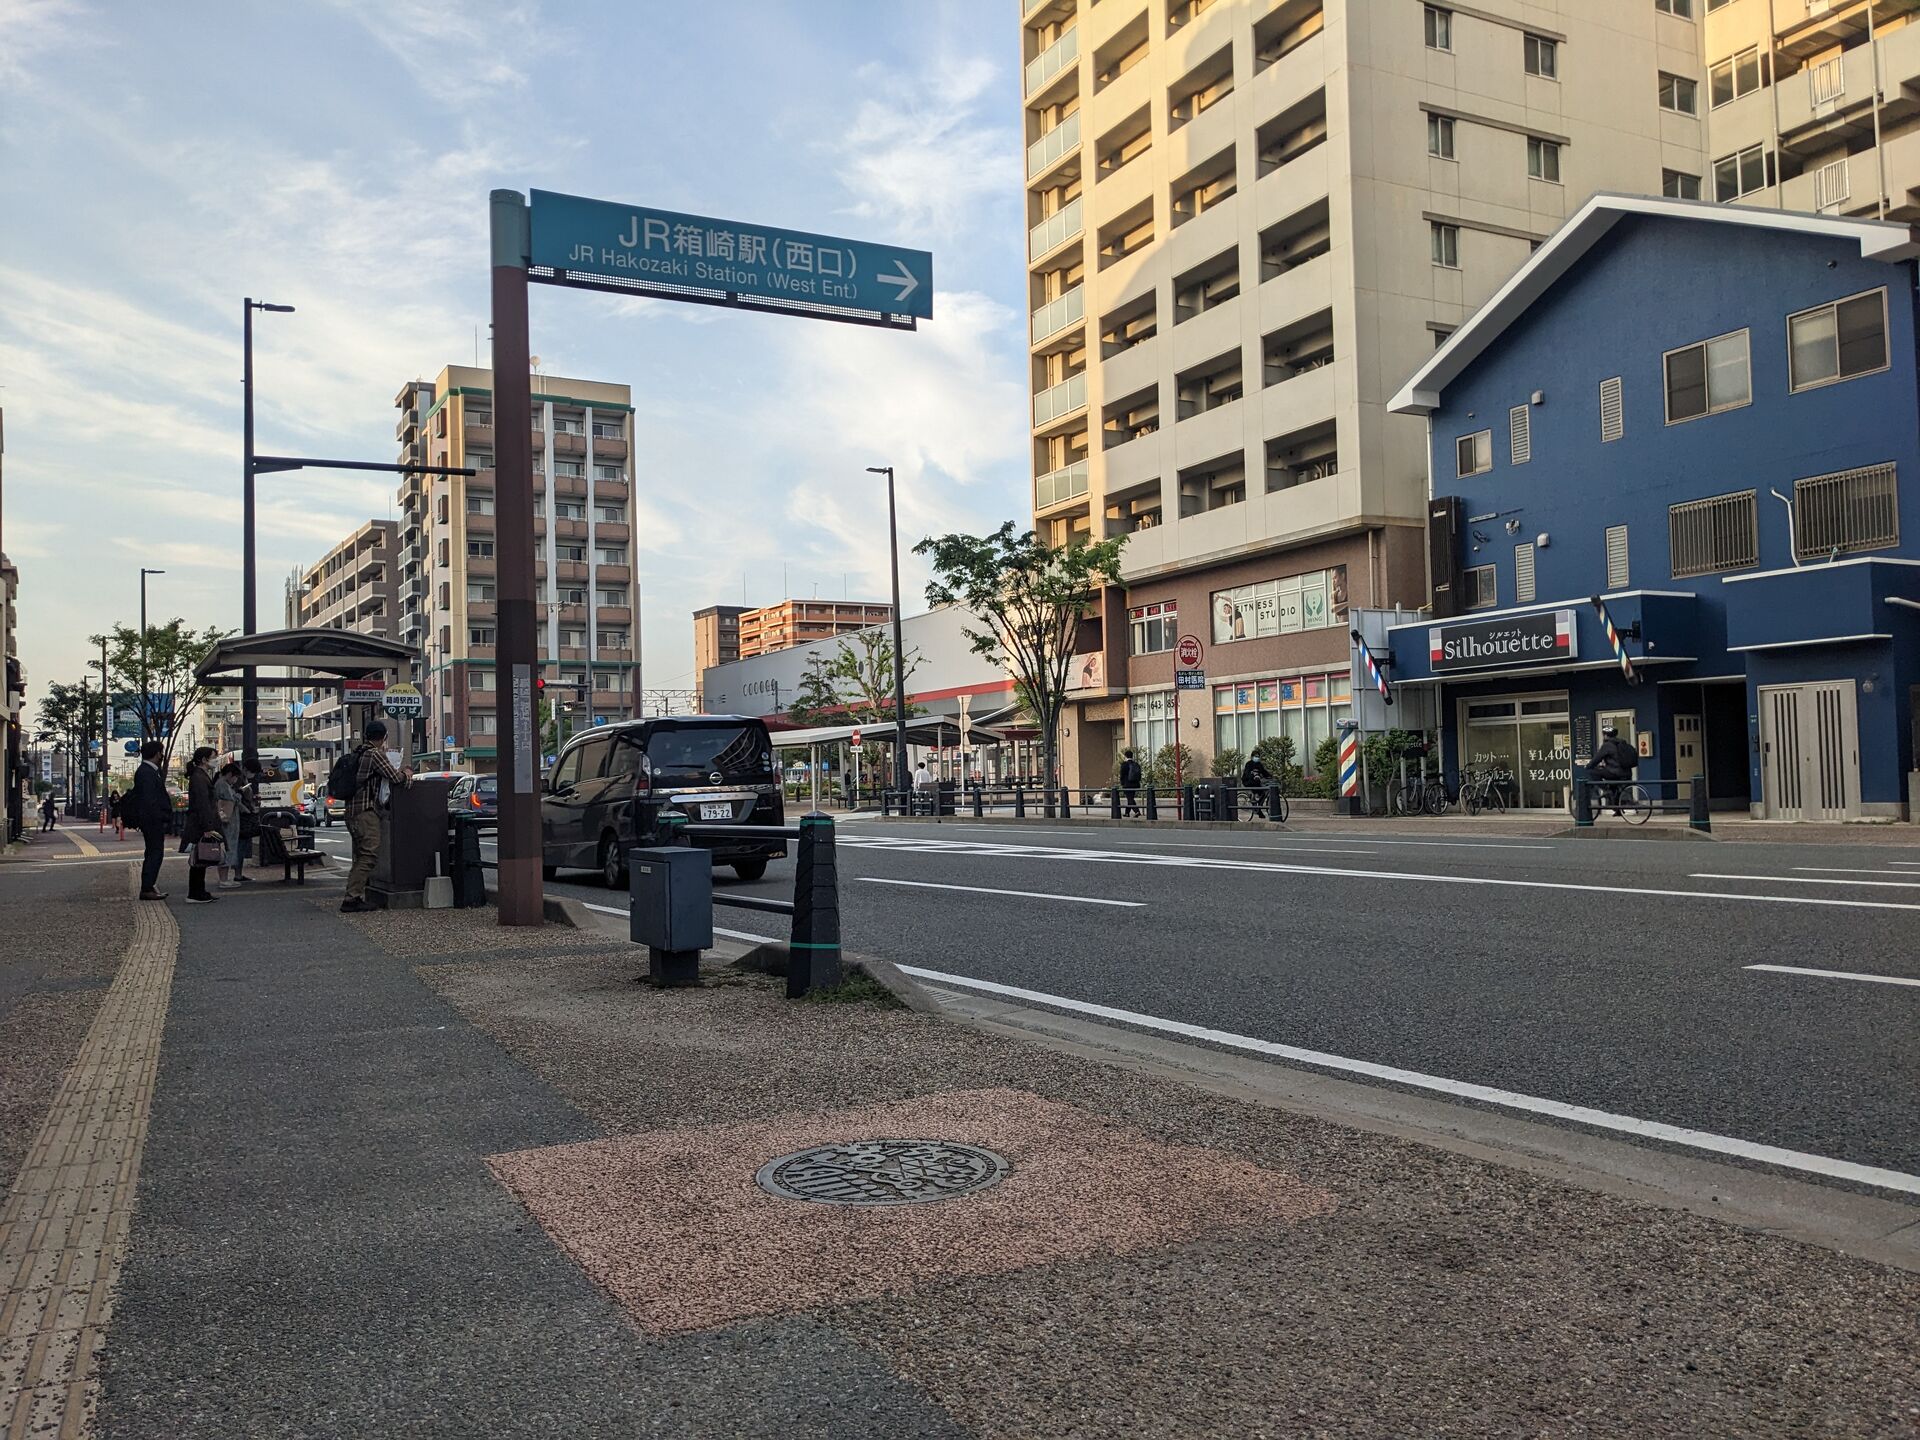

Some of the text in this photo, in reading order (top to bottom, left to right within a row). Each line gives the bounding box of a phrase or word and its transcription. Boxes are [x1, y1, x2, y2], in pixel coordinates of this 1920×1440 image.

[618, 216, 857, 279] JR箱崎駅(西口)
[568, 244, 858, 300] JR Hakozaki Station (West Ent.)
[1236, 600, 1273, 612] FITNESS
[1260, 607, 1296, 619] STUDIO
[1488, 628, 1521, 639] シルエット
[1444, 634, 1553, 660] Silhouette
[1178, 676, 1204, 684] 田村医院
[388, 706, 417, 714] のりば
[1529, 748, 1570, 761] ¥1,400
[1529, 769, 1571, 781] ¥2,400
[707, 809, 730, 818] 79-22
